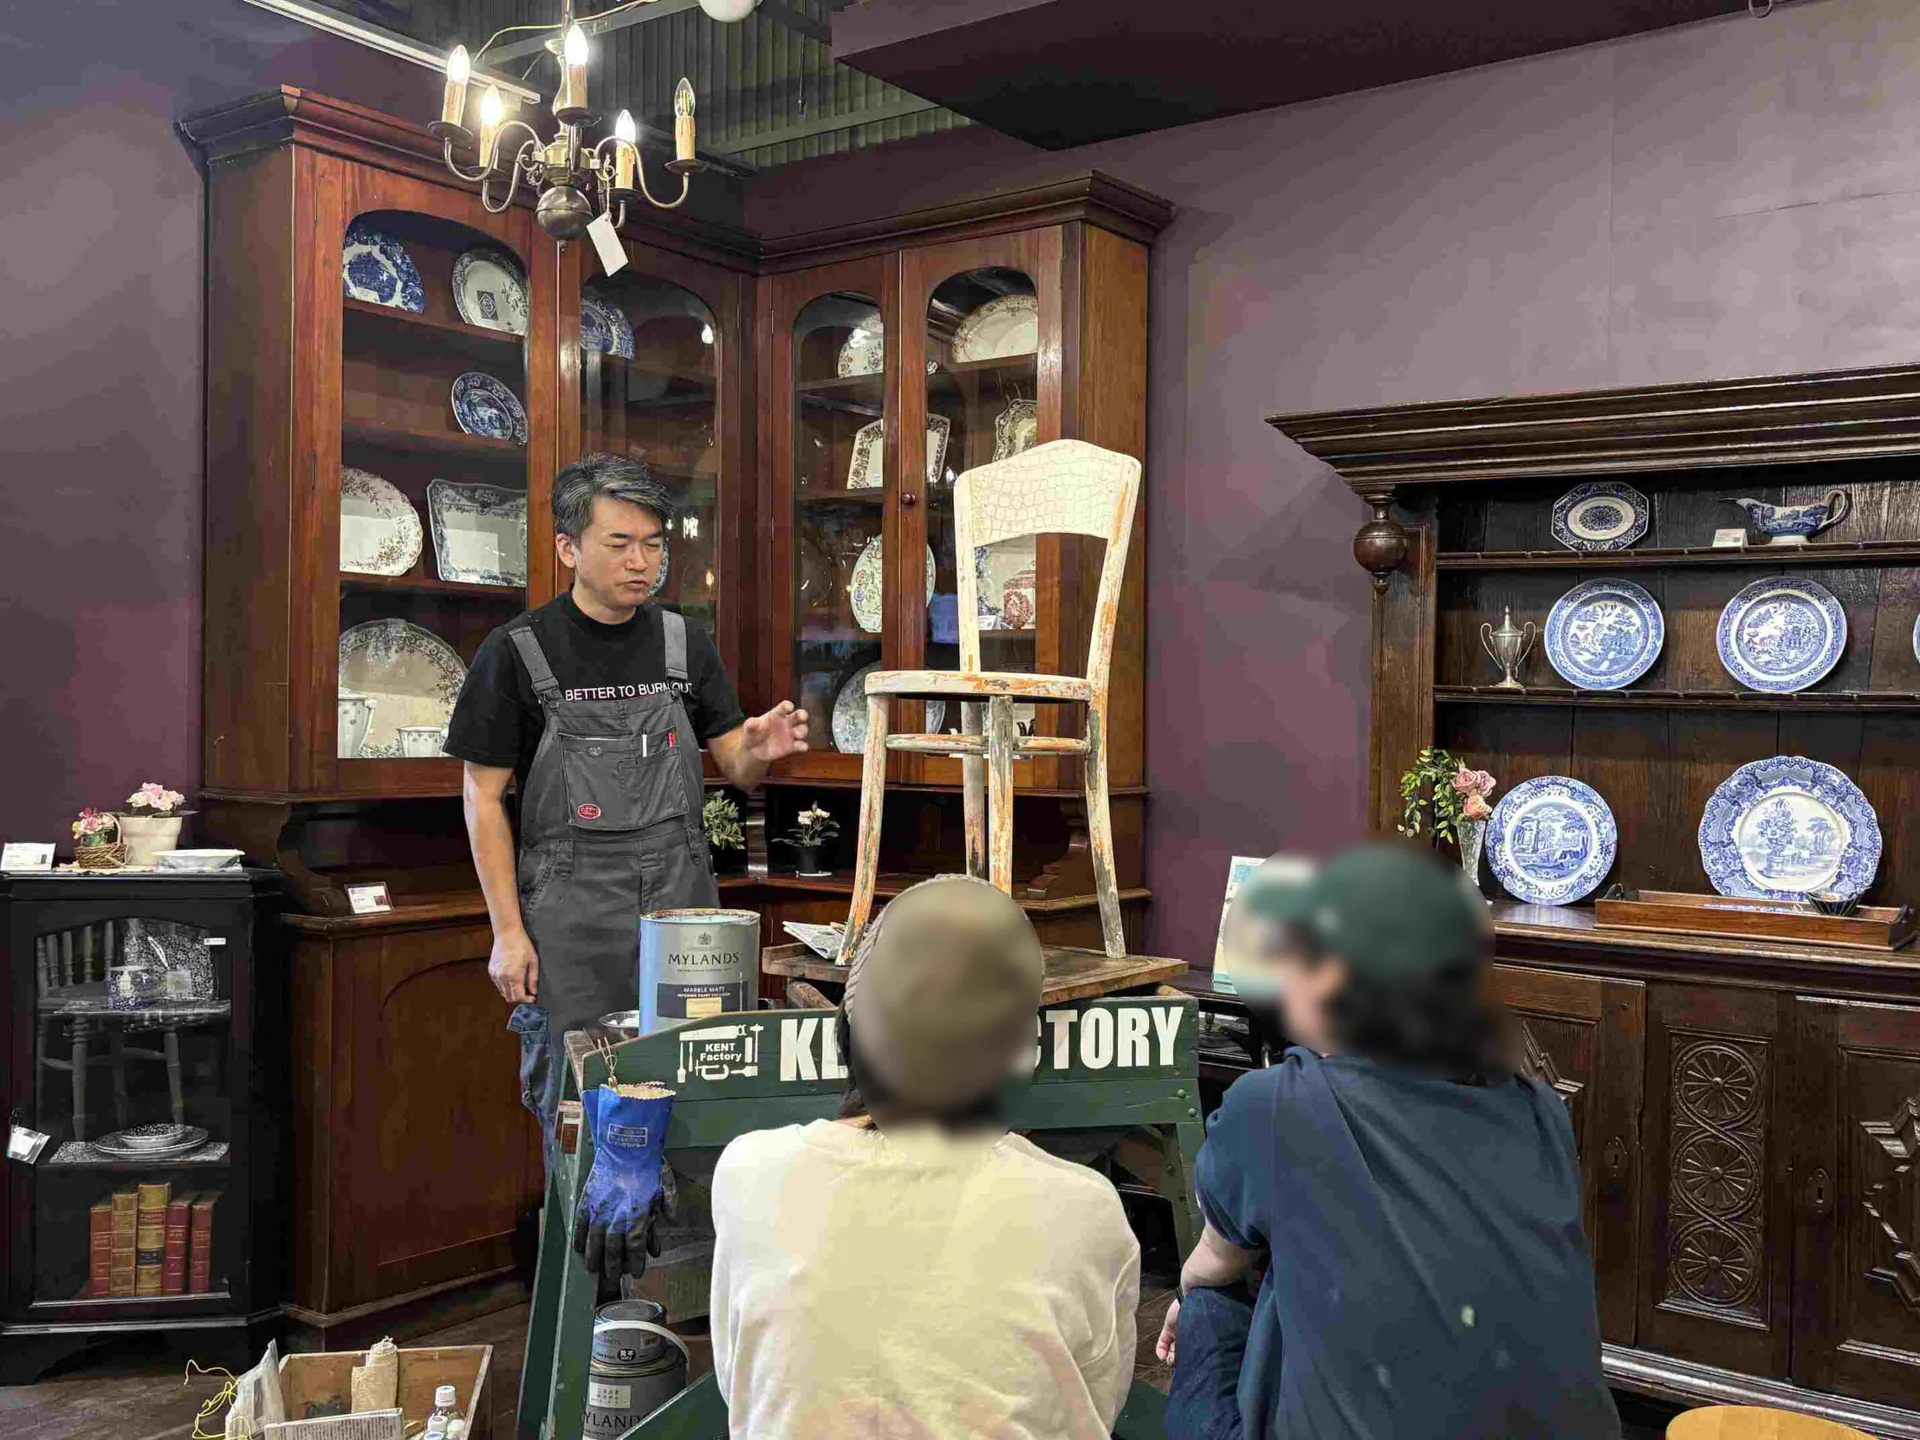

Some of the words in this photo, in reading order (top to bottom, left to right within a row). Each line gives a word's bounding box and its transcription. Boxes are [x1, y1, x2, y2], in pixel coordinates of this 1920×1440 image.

[565, 686, 616, 701] BETTER
[618, 685, 636, 697] TO
[668, 952, 739, 965] MYLANDS
[705, 1042, 736, 1052] KENT
[780, 1017, 850, 1081] KE
[1033, 1006, 1184, 1070] TORY
[700, 1053, 742, 1062] Factory
[583, 1412, 650, 1429] YLAND
